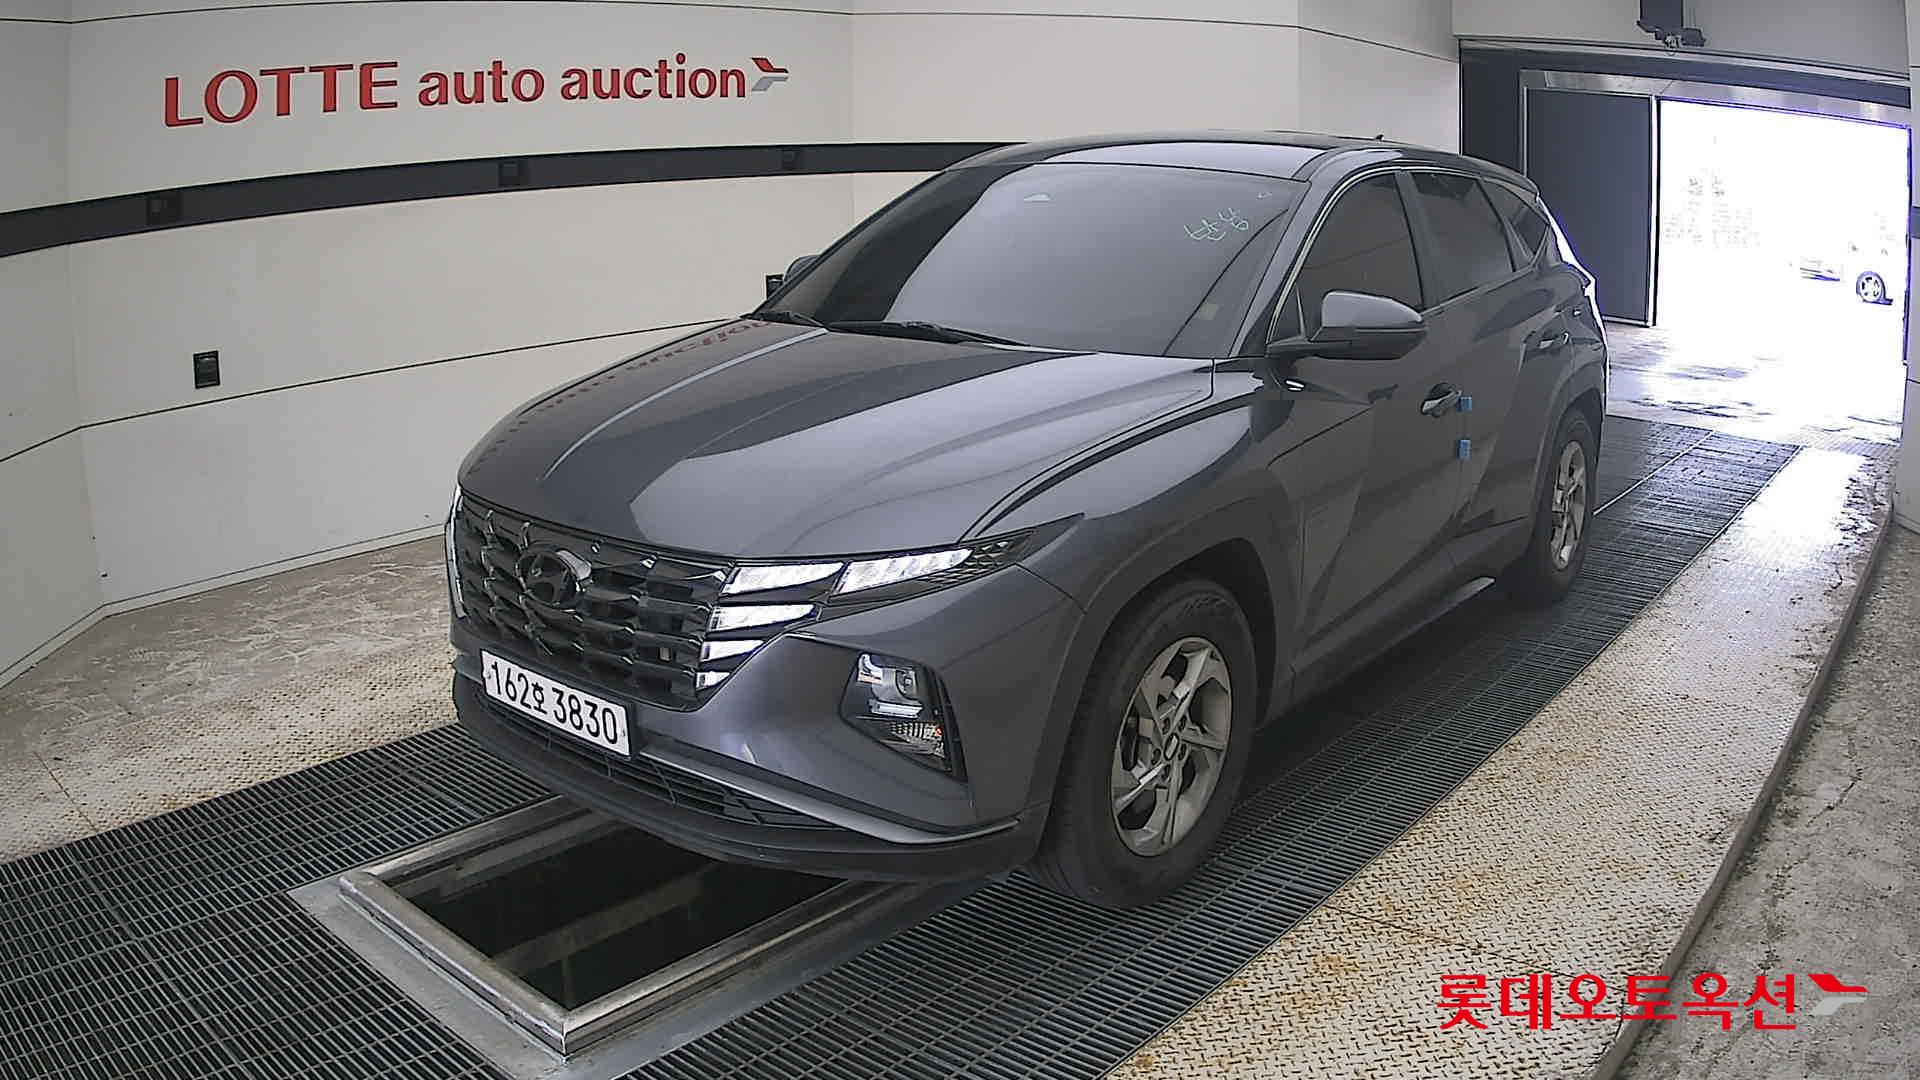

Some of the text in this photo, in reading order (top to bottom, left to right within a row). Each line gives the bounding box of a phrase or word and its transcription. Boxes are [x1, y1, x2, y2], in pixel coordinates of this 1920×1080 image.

[165, 53, 746, 126] LOTTE auto auction
